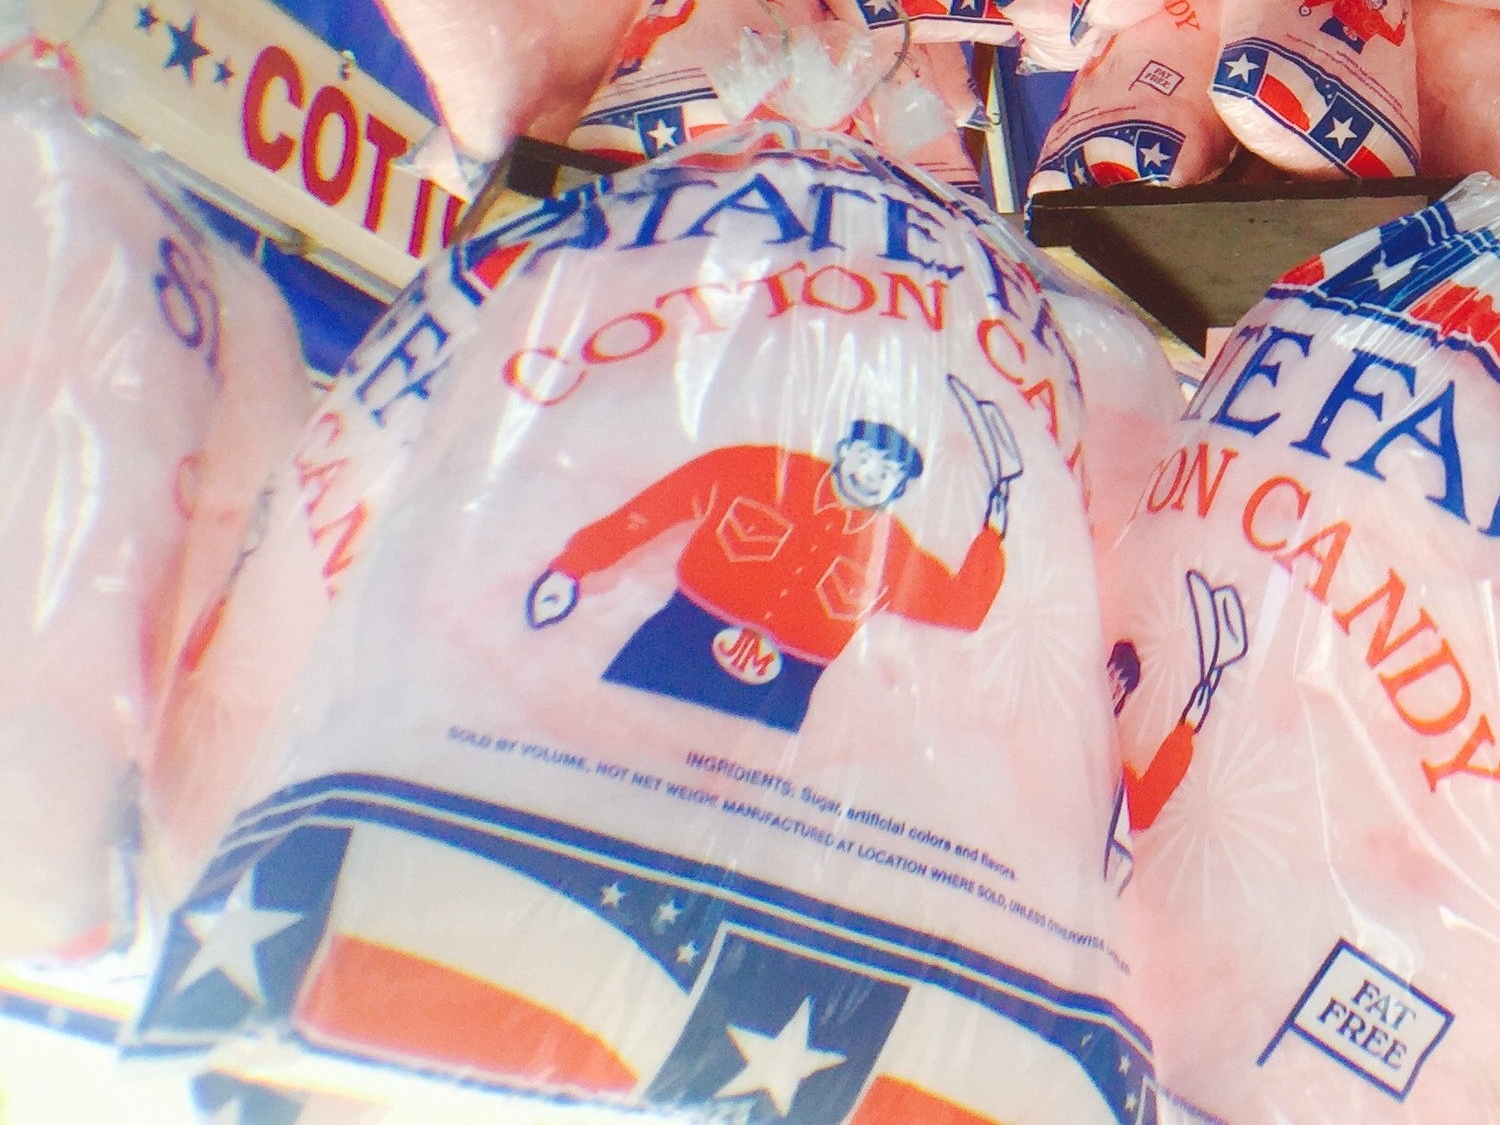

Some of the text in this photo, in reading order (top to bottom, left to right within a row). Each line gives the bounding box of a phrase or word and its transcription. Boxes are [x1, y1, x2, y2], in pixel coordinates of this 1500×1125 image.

[502, 260, 949, 407] COTTON
[448, 725, 492, 750] SOLD
[495, 737, 519, 754] BY
[595, 761, 629, 782] NOT
[631, 771, 662, 792] NET
[721, 798, 834, 847] MANUFACTURED
[835, 836, 856, 853] AT
[857, 842, 928, 877] LOCATION
[930, 866, 975, 894] WHERE
[685, 750, 796, 798] INGREDIENTS:
[846, 807, 906, 835] artificial
[907, 825, 952, 852] colors
[954, 842, 980, 862] and
[1316, 997, 1408, 1070] FREE
[1351, 979, 1417, 1030] FAT
